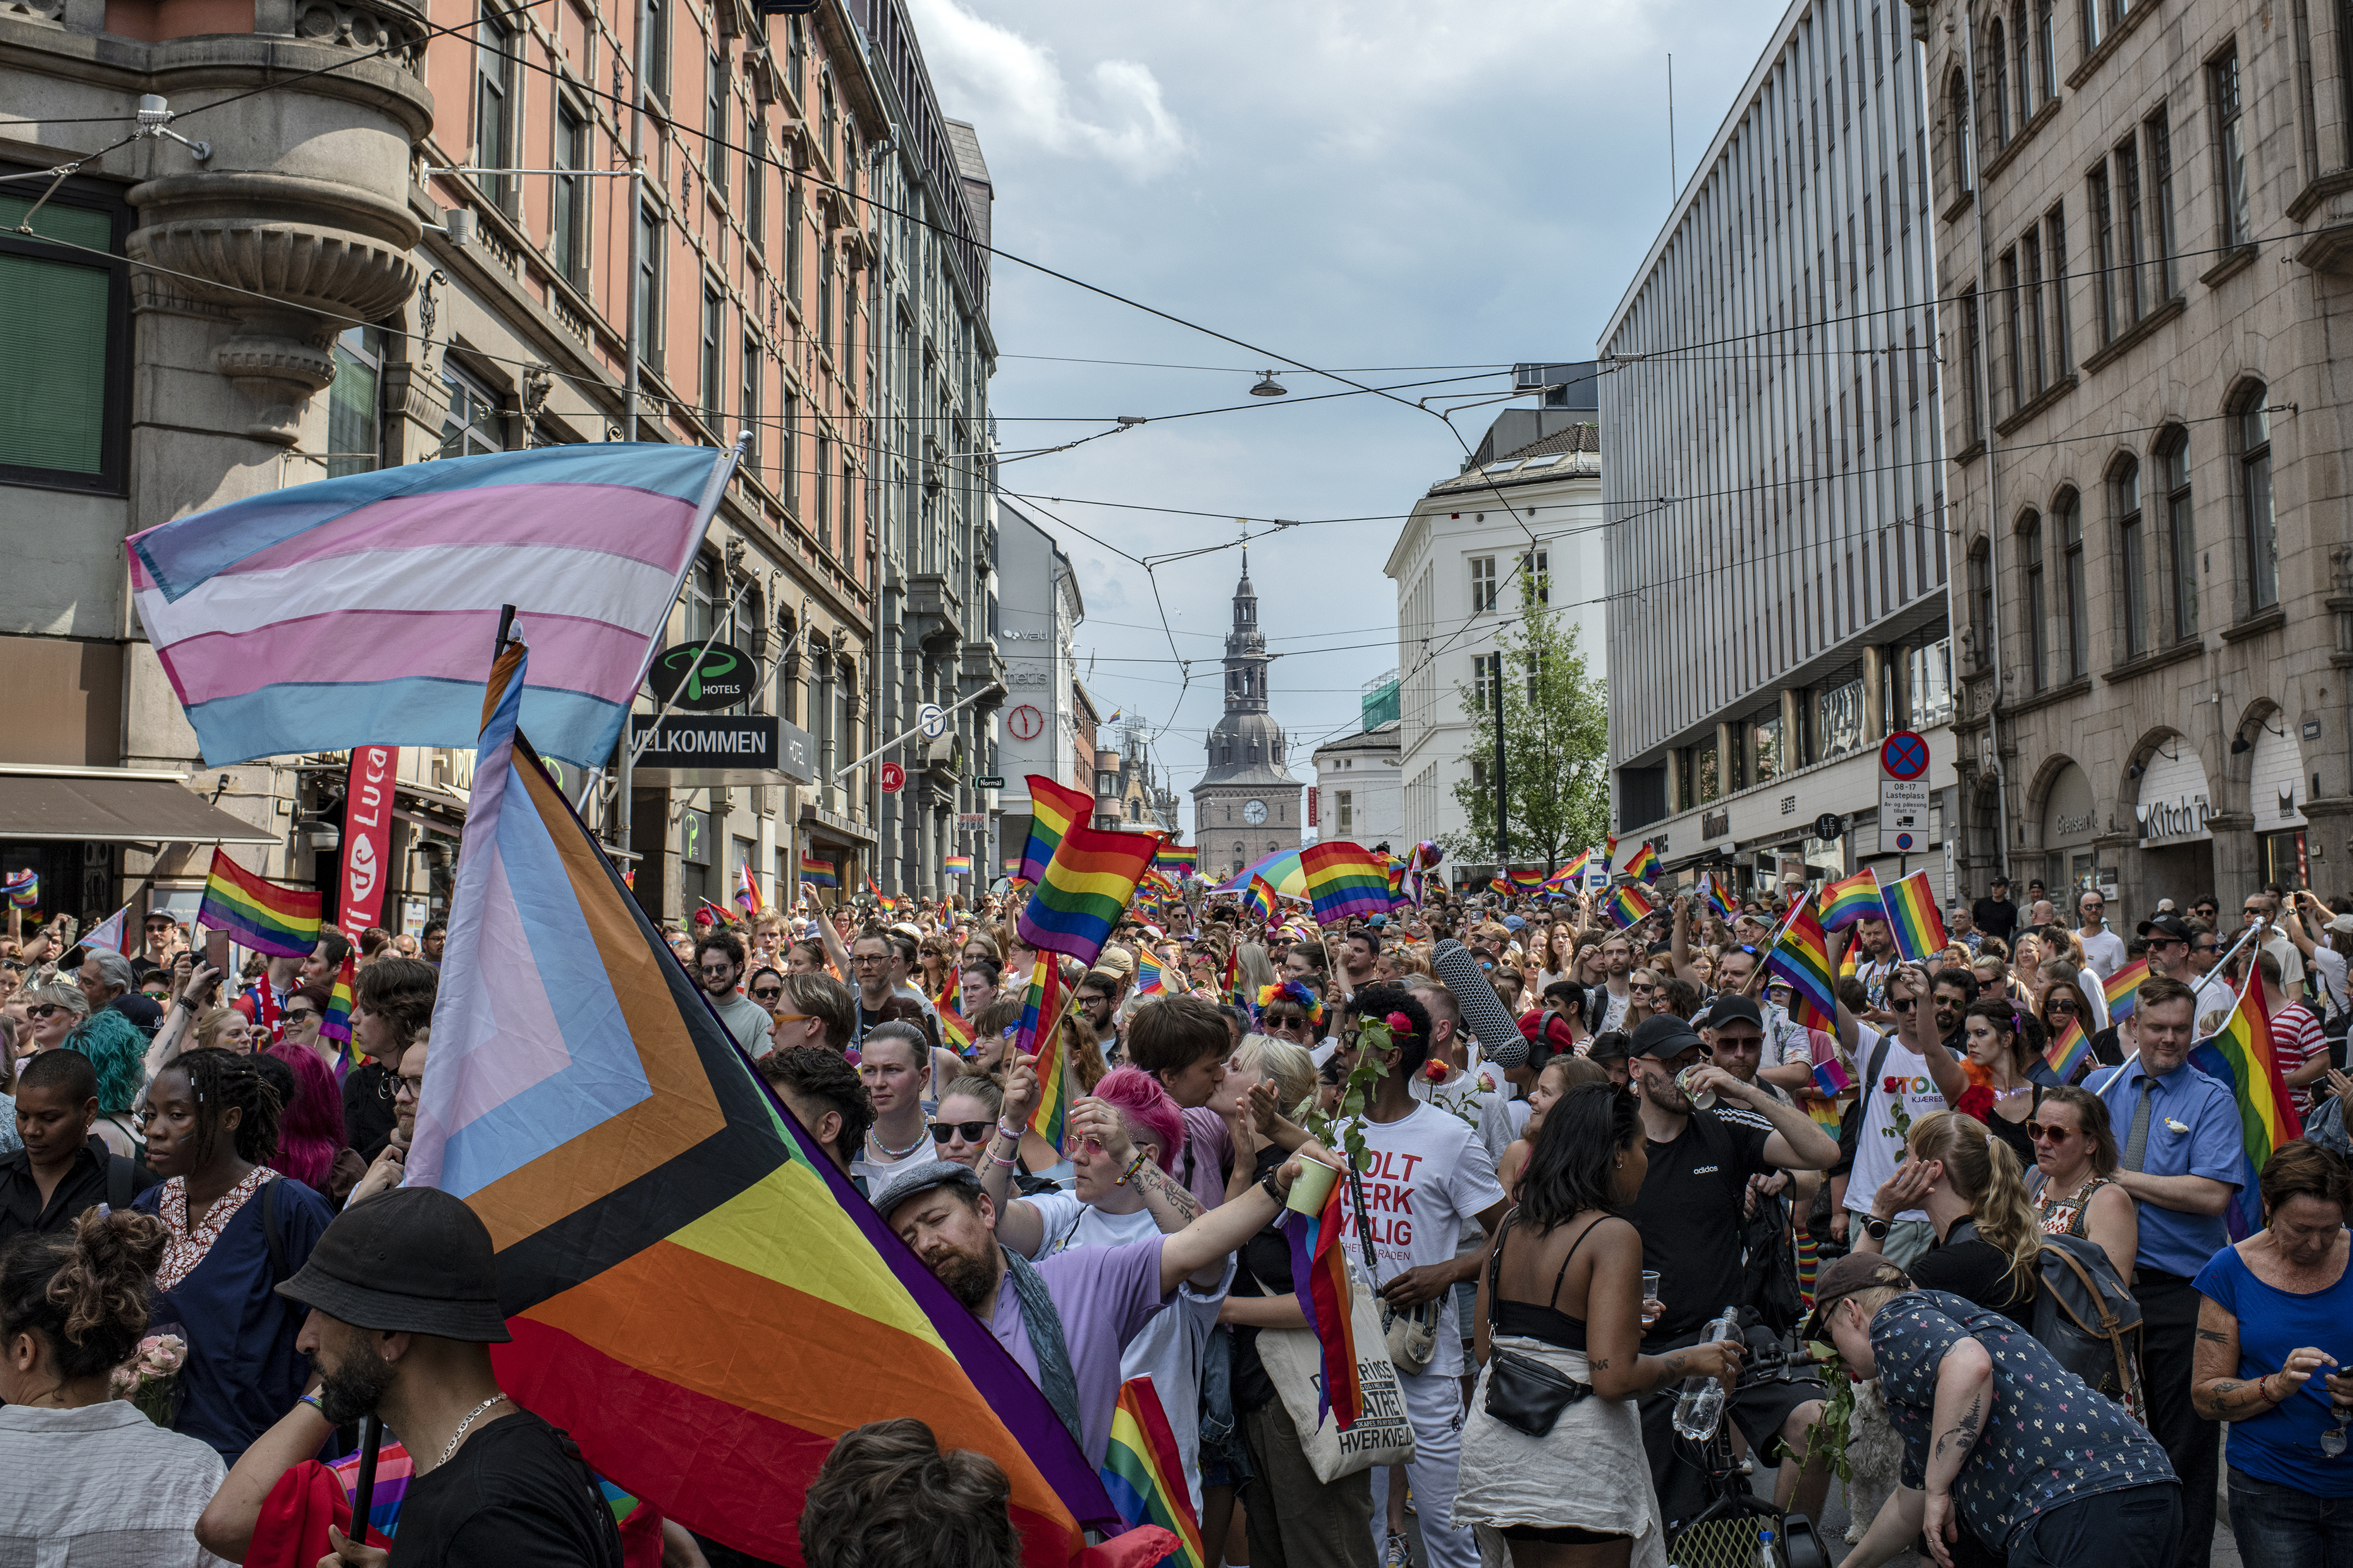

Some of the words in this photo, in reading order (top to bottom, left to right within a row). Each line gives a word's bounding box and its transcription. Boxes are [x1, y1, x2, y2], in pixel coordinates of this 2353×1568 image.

[1019, 629, 1048, 640] Vali
[1005, 669, 1048, 684] metis
[702, 685, 740, 695] HOTELS
[631, 729, 766, 753] VELKOMMEN
[789, 739, 805, 766] HOTEL
[354, 748, 388, 828] Luca
[1886, 792, 1925, 800] Lasteplass
[959, 814, 985, 822] PINK
[2057, 814, 2088, 834] Grensen
[1337, 1150, 1422, 1182] OLT
[1694, 1166, 1718, 1175] adidas
[1343, 1180, 1415, 1215] TERK
[1340, 1212, 1412, 1246] YLIG
[1358, 1390, 1404, 1418] ATRET
[1338, 1429, 1380, 1455] HVER
